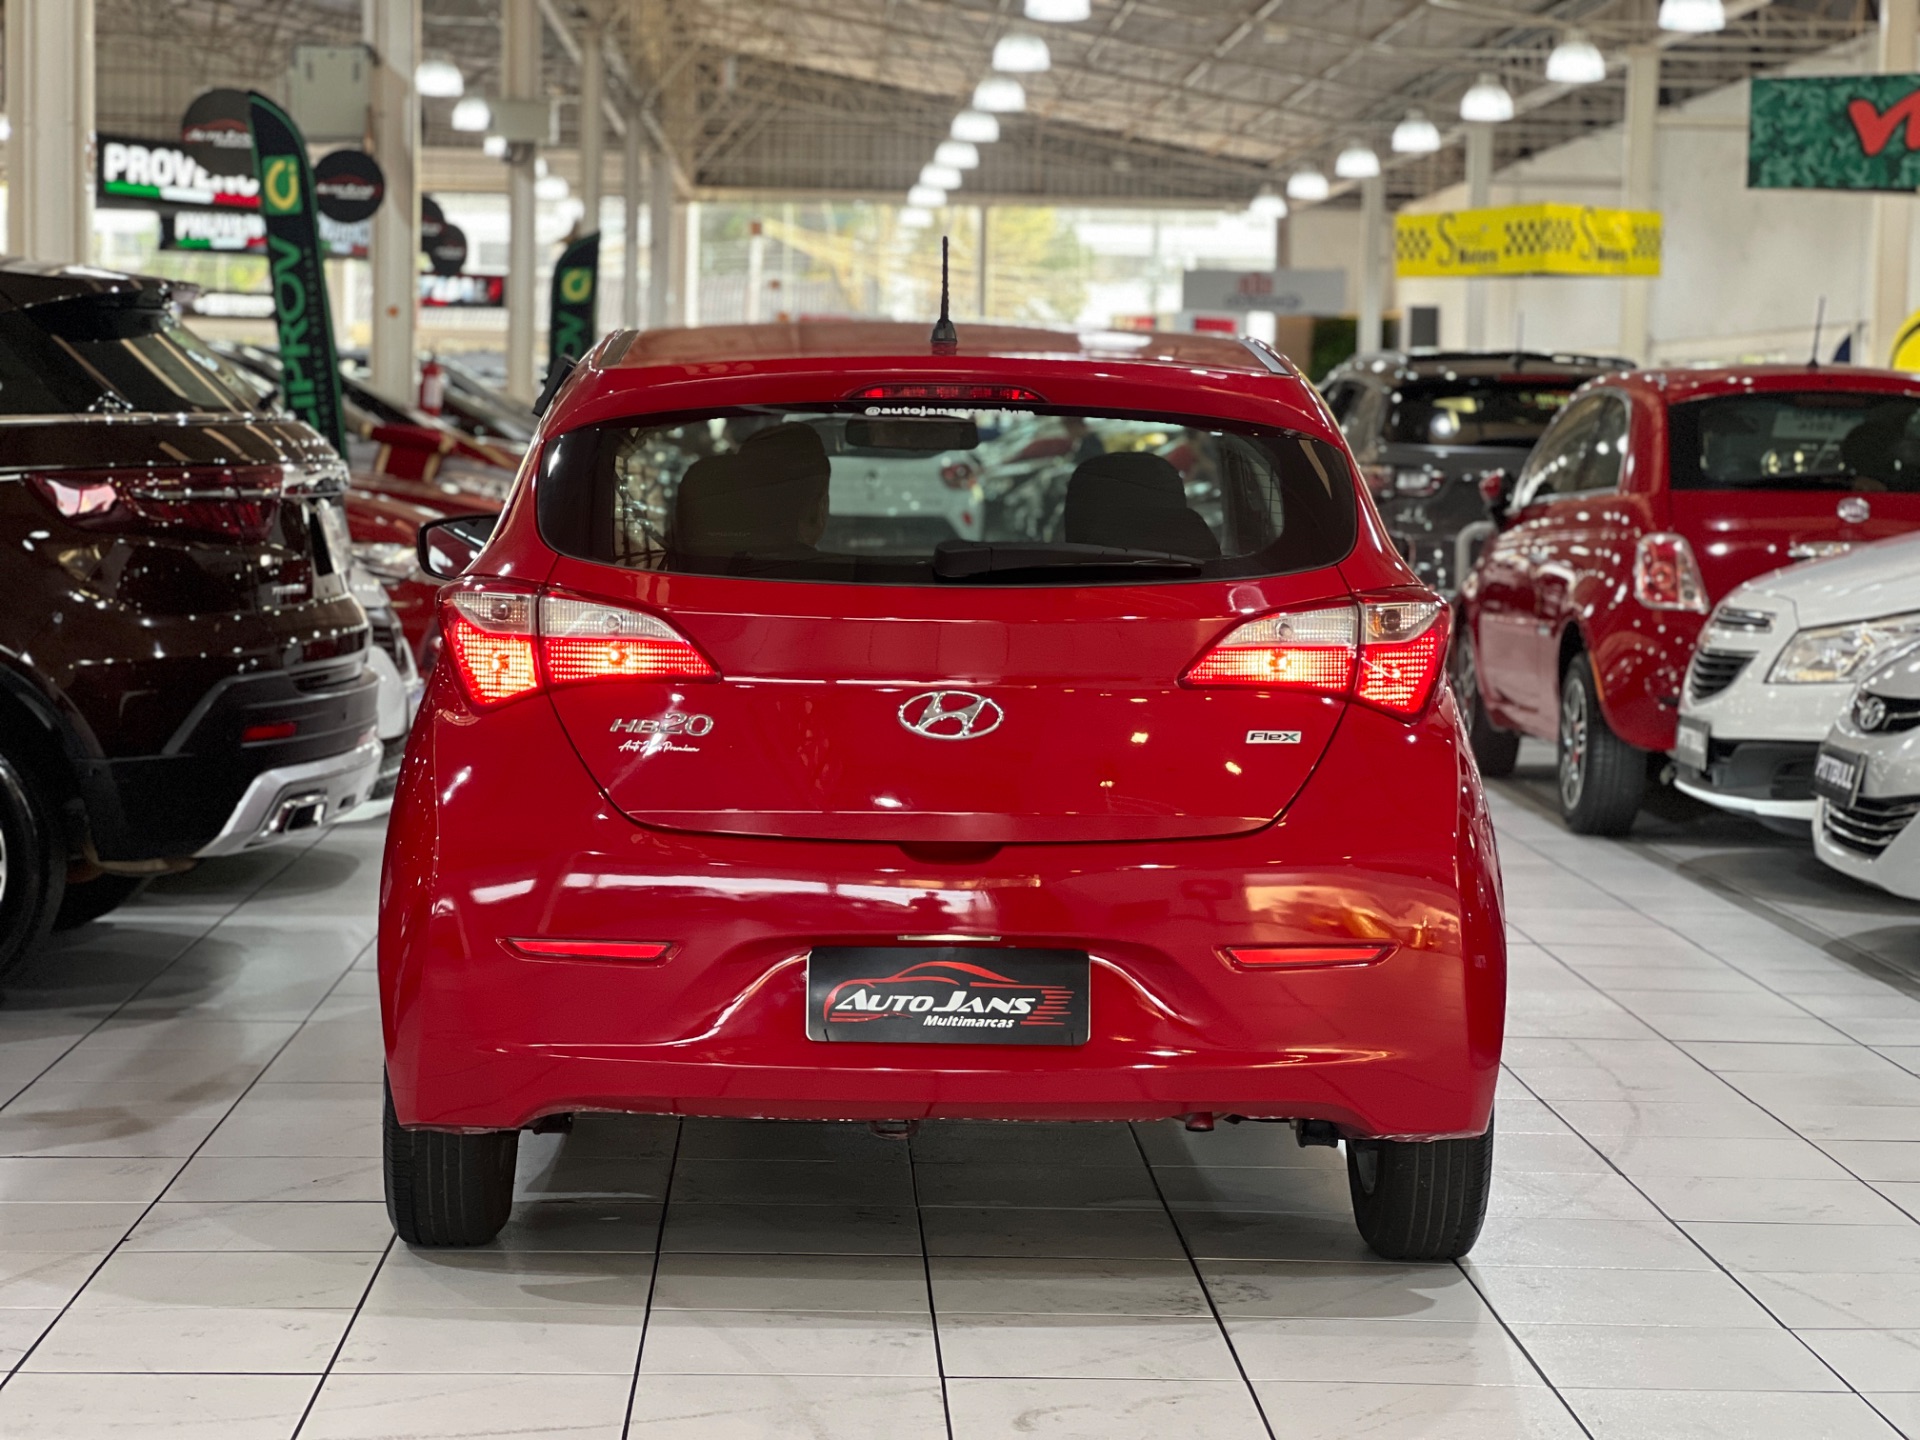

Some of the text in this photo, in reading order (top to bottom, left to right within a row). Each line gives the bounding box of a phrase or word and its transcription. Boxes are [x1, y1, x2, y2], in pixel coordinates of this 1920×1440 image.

[609, 712, 714, 737] HB20
[836, 988, 1036, 1014] AUTO JANS
[923, 1014, 1015, 1029] Multimarcas
